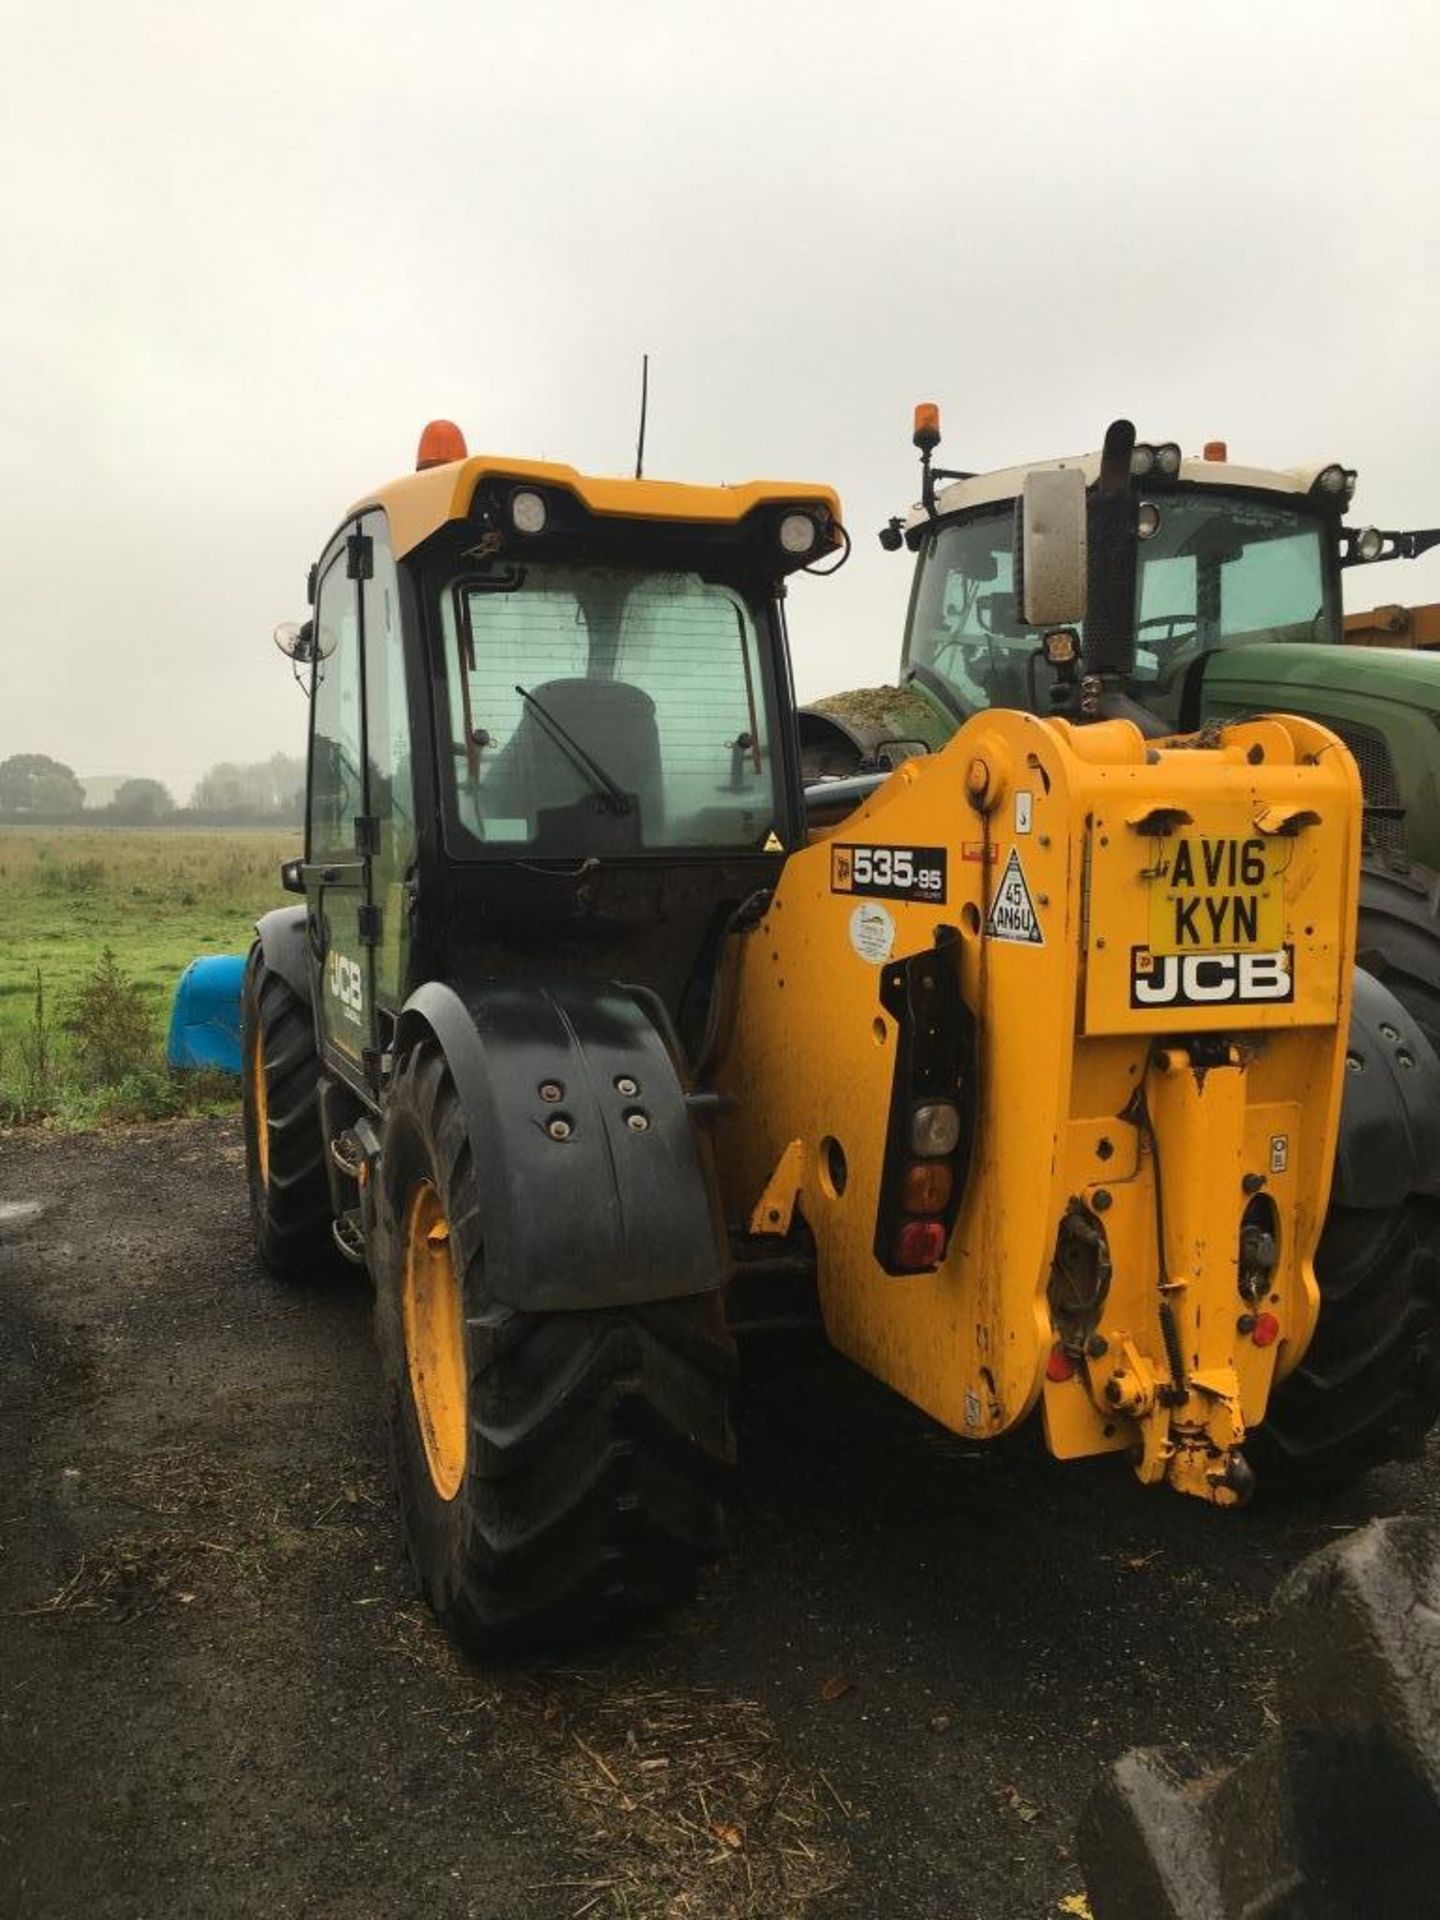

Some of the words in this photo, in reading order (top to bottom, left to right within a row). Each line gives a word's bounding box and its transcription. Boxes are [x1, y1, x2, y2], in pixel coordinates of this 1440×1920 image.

[854, 849, 942, 890] 535-95
[1171, 839, 1266, 887] AV16
[1006, 883, 1022, 906] 45
[1175, 896, 1257, 945] KYN
[330, 950, 362, 1012] JCB
[1135, 952, 1291, 1003] JCB
